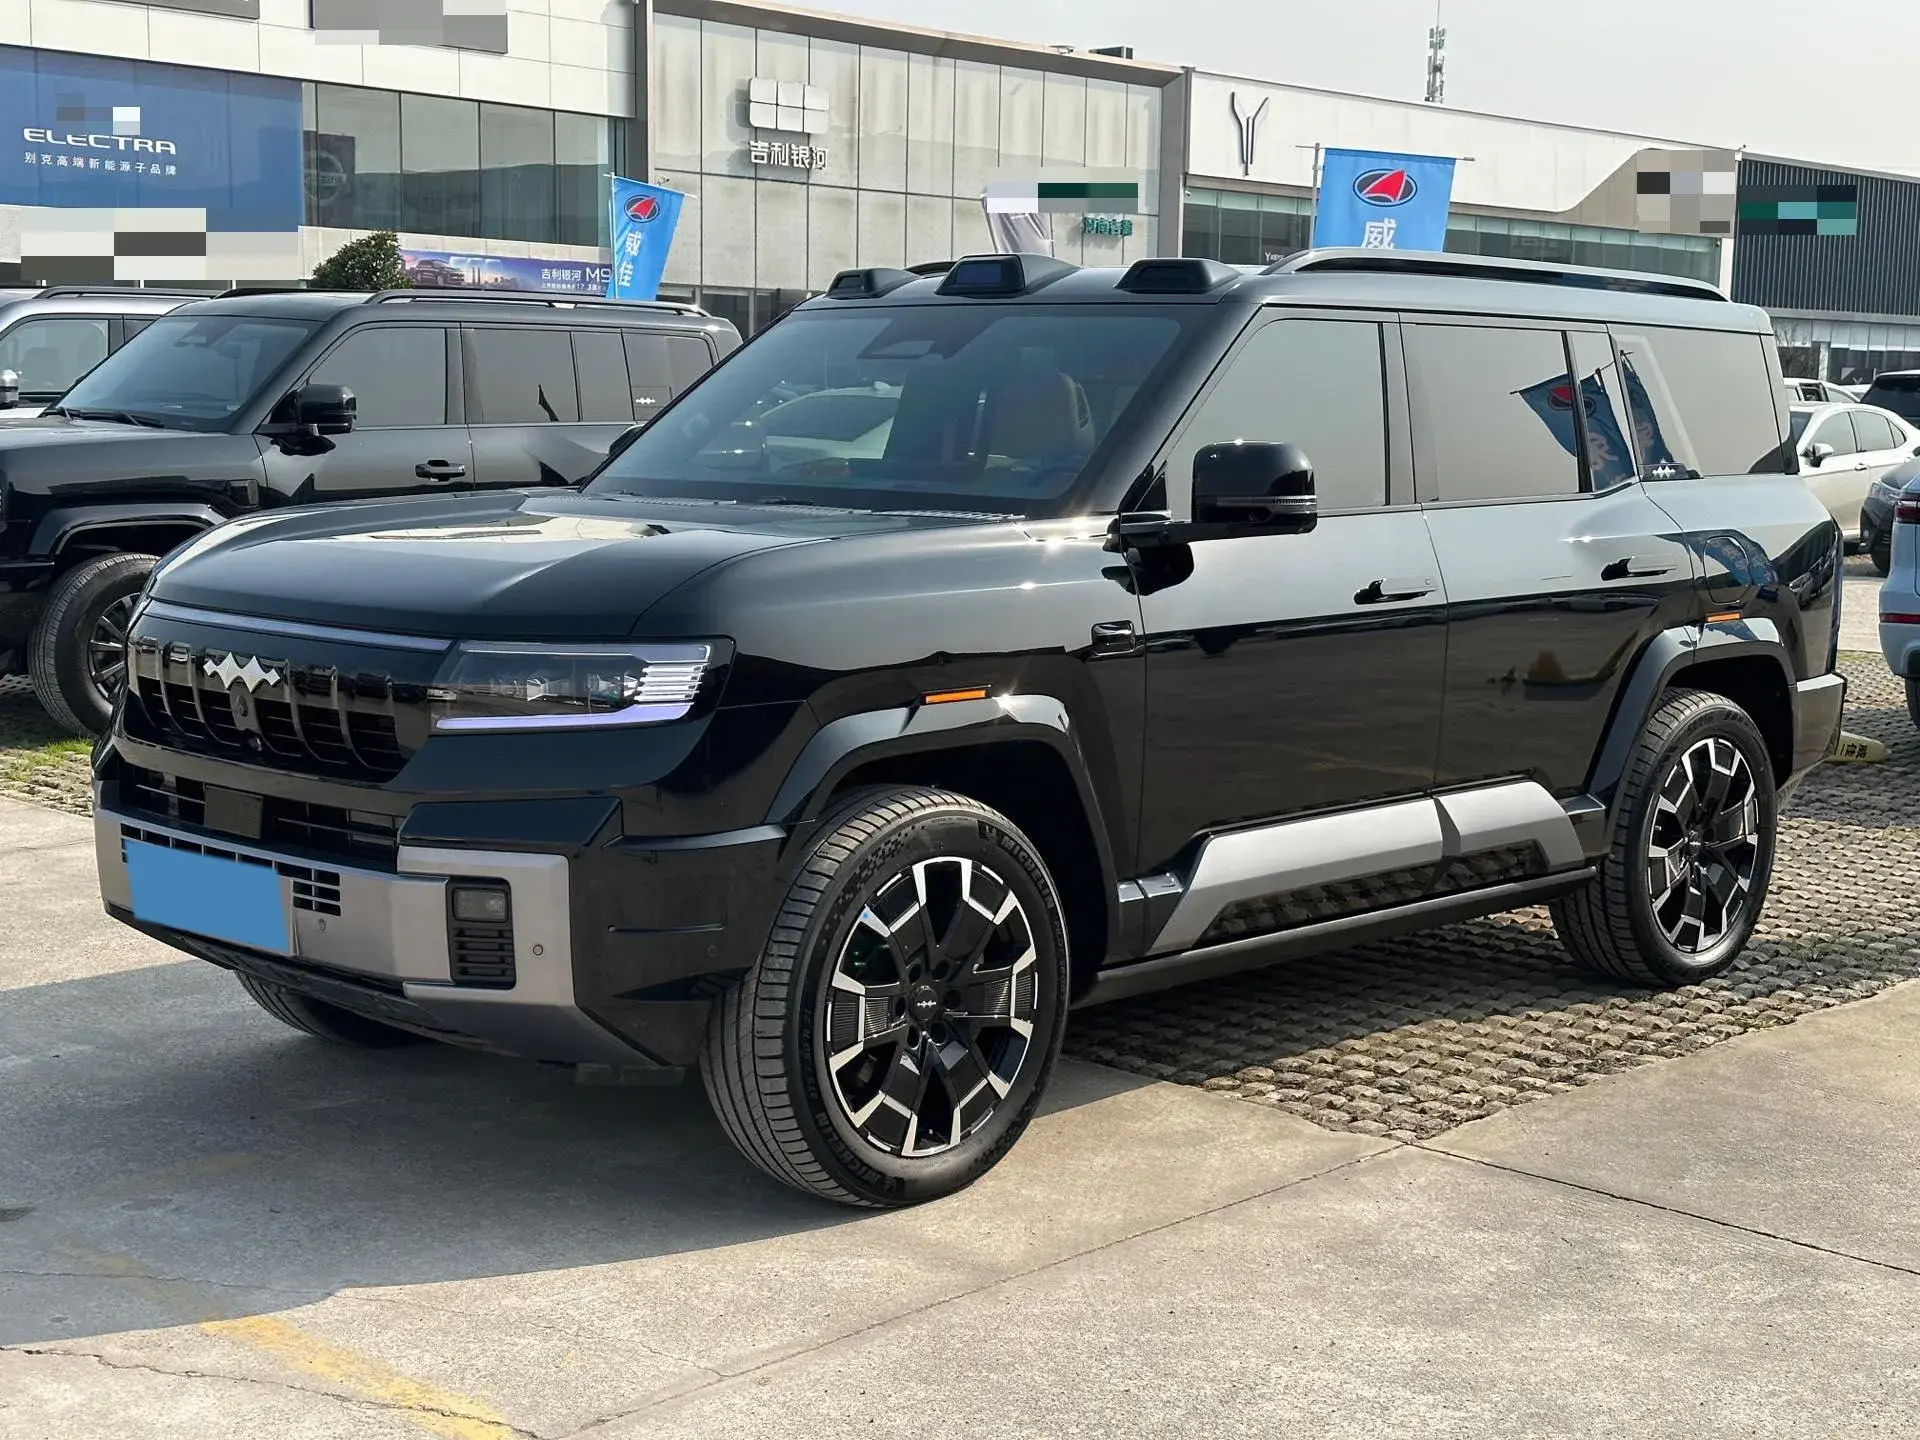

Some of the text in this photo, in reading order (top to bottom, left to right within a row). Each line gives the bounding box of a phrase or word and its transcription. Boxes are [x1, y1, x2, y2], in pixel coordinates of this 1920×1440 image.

[23, 128, 177, 155] ELECTRA
[749, 140, 829, 170] 吉利银河
[24, 151, 177, 176] 别克高端新能源子品牌
[1361, 217, 1397, 249] 威
[541, 267, 611, 283] 吉利银河 M9
[1001, 834, 1055, 909] MICHELIN
